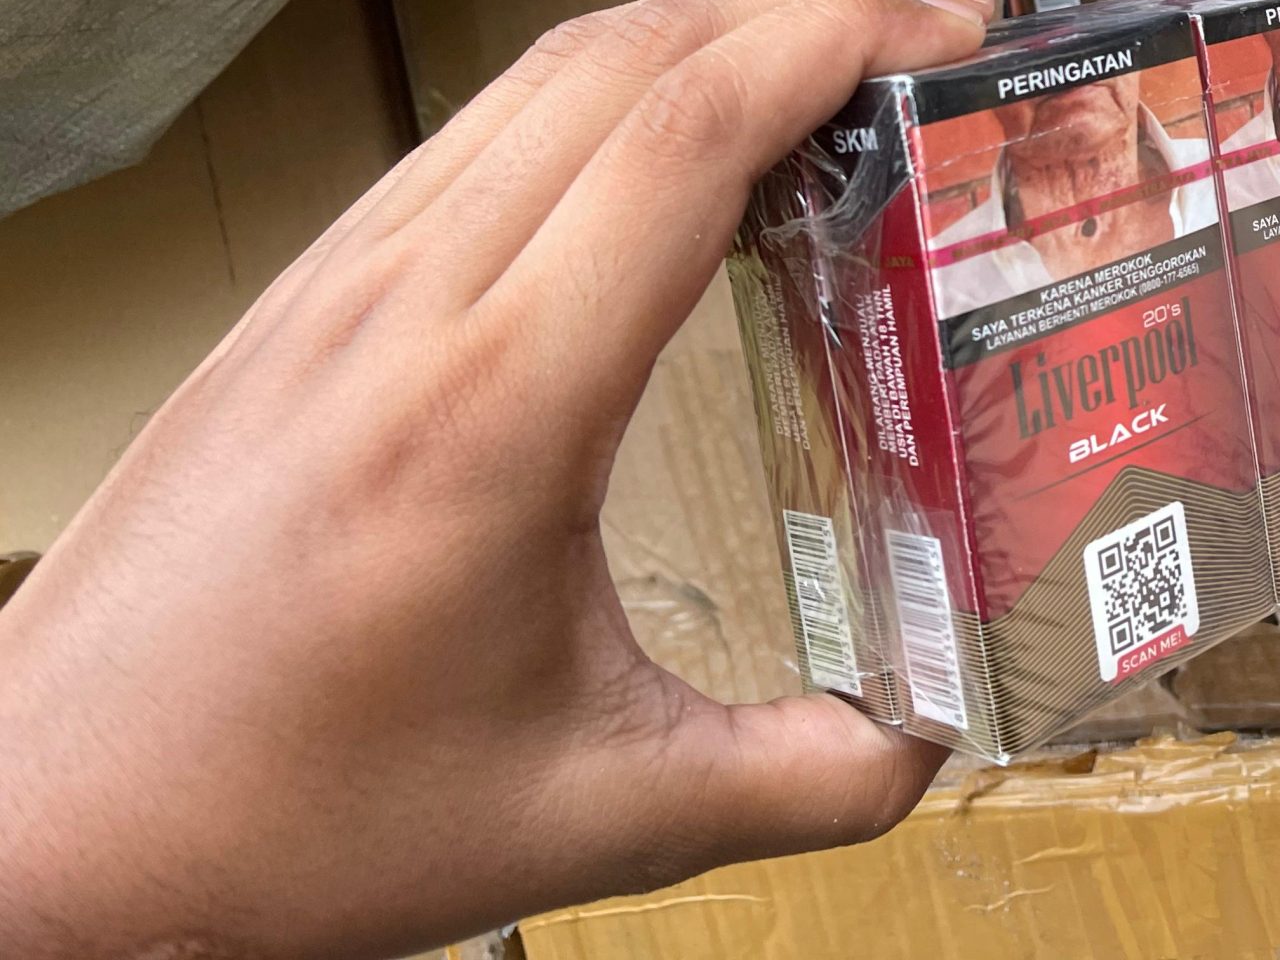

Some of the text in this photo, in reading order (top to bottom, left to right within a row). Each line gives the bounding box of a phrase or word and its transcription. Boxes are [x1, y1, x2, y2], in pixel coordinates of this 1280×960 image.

[998, 49, 1133, 99] PERINGATAN
[832, 128, 878, 154] SKM
[1252, 215, 1278, 232] SAYA
[971, 245, 1207, 342] SAYA TERKENA KANKER TENGGOROKAN
[1040, 253, 1153, 303] KARENA MEROKOK
[986, 324, 1037, 351] LAYANAN
[1039, 306, 1089, 333] BERHENTI
[1090, 288, 1138, 312] MEROKOK
[1142, 303, 1181, 329] 20's
[863, 292, 897, 453] MEMBERI PADA ANAK
[872, 288, 908, 458] USIA DI BAWAH 18 THN
[881, 283, 919, 467] DAN PEREMPUAN HAMIL
[1009, 295, 1199, 440] Liverpool
[798, 420, 811, 449] DAN
[868, 373, 888, 450] DILARANG
[1068, 403, 1169, 464] BLACK
[1122, 630, 1182, 673] SCAN ME!
